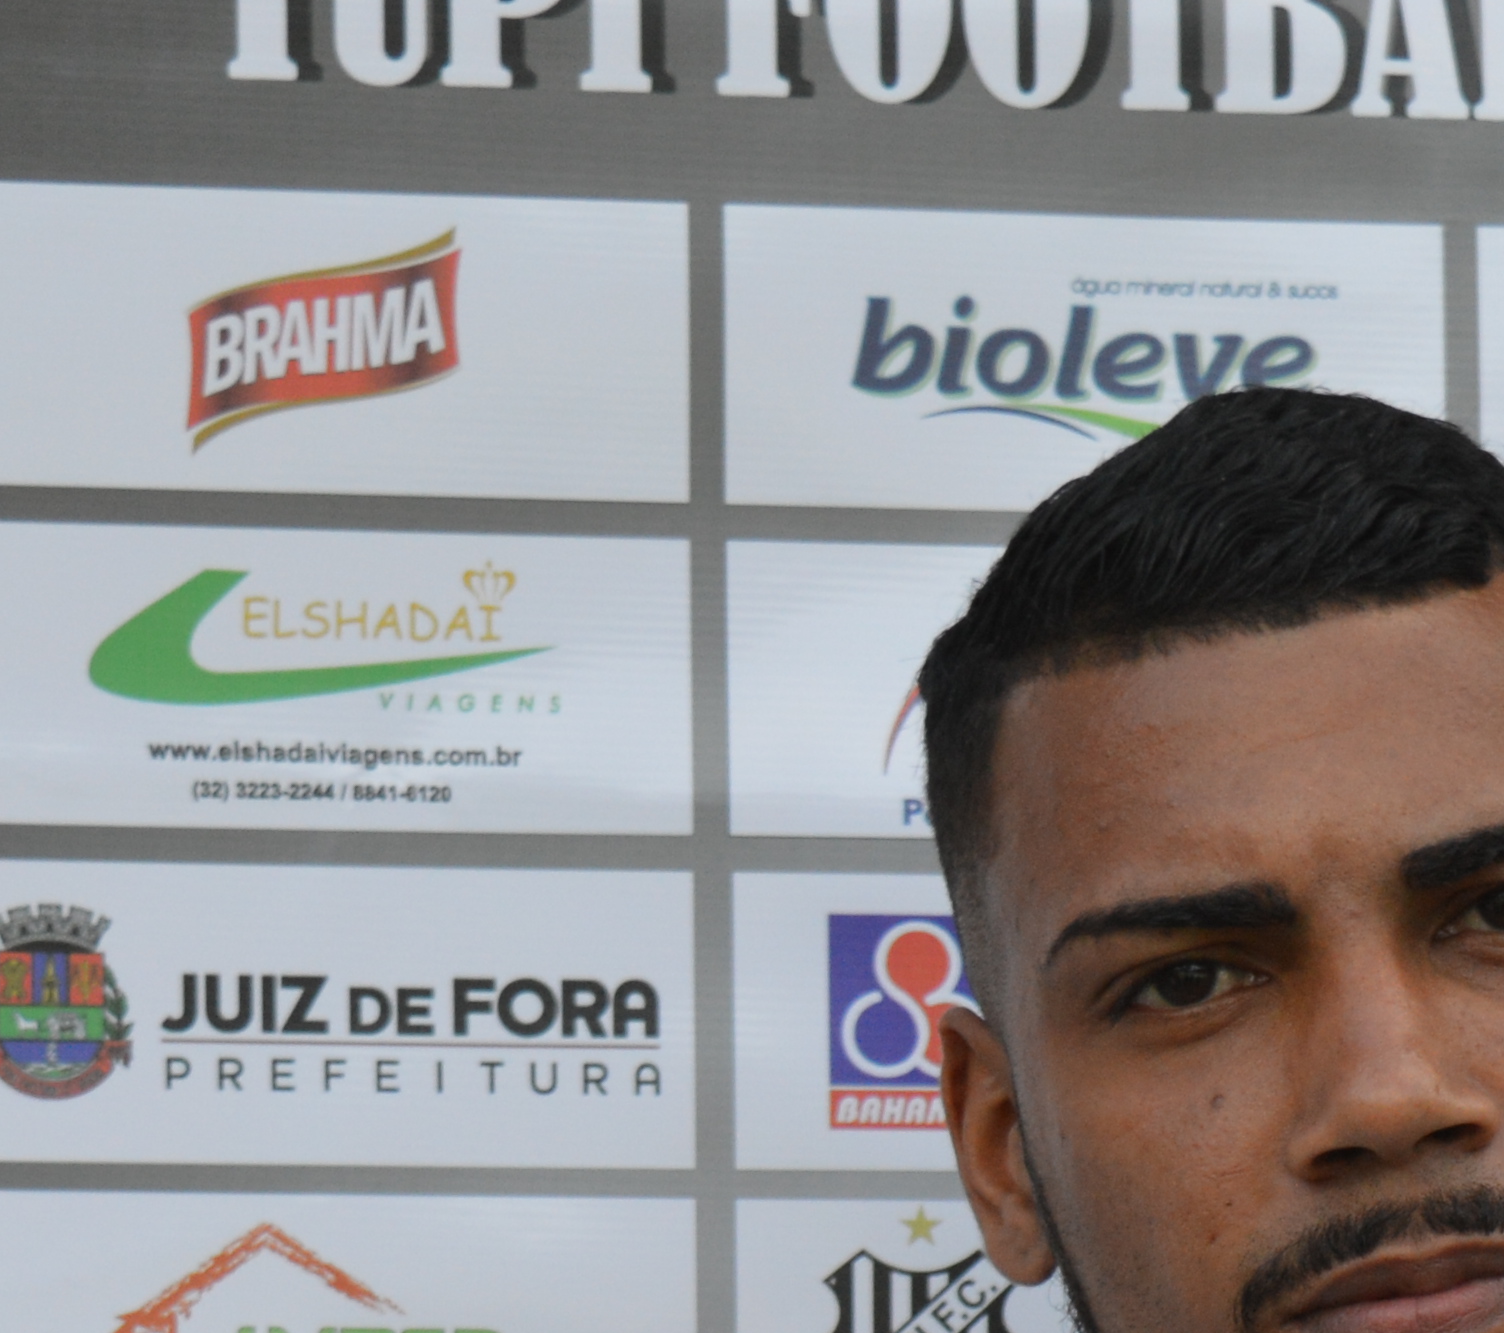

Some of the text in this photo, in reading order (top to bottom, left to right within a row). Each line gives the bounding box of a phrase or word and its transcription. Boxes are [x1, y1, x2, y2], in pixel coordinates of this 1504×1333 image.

[203, 277, 444, 398] BRAHMA
[380, 692, 562, 714] VIAGENS
[161, 973, 659, 1038] JUIZ DE FORA
[165, 1056, 661, 1096] PREFEITURA
